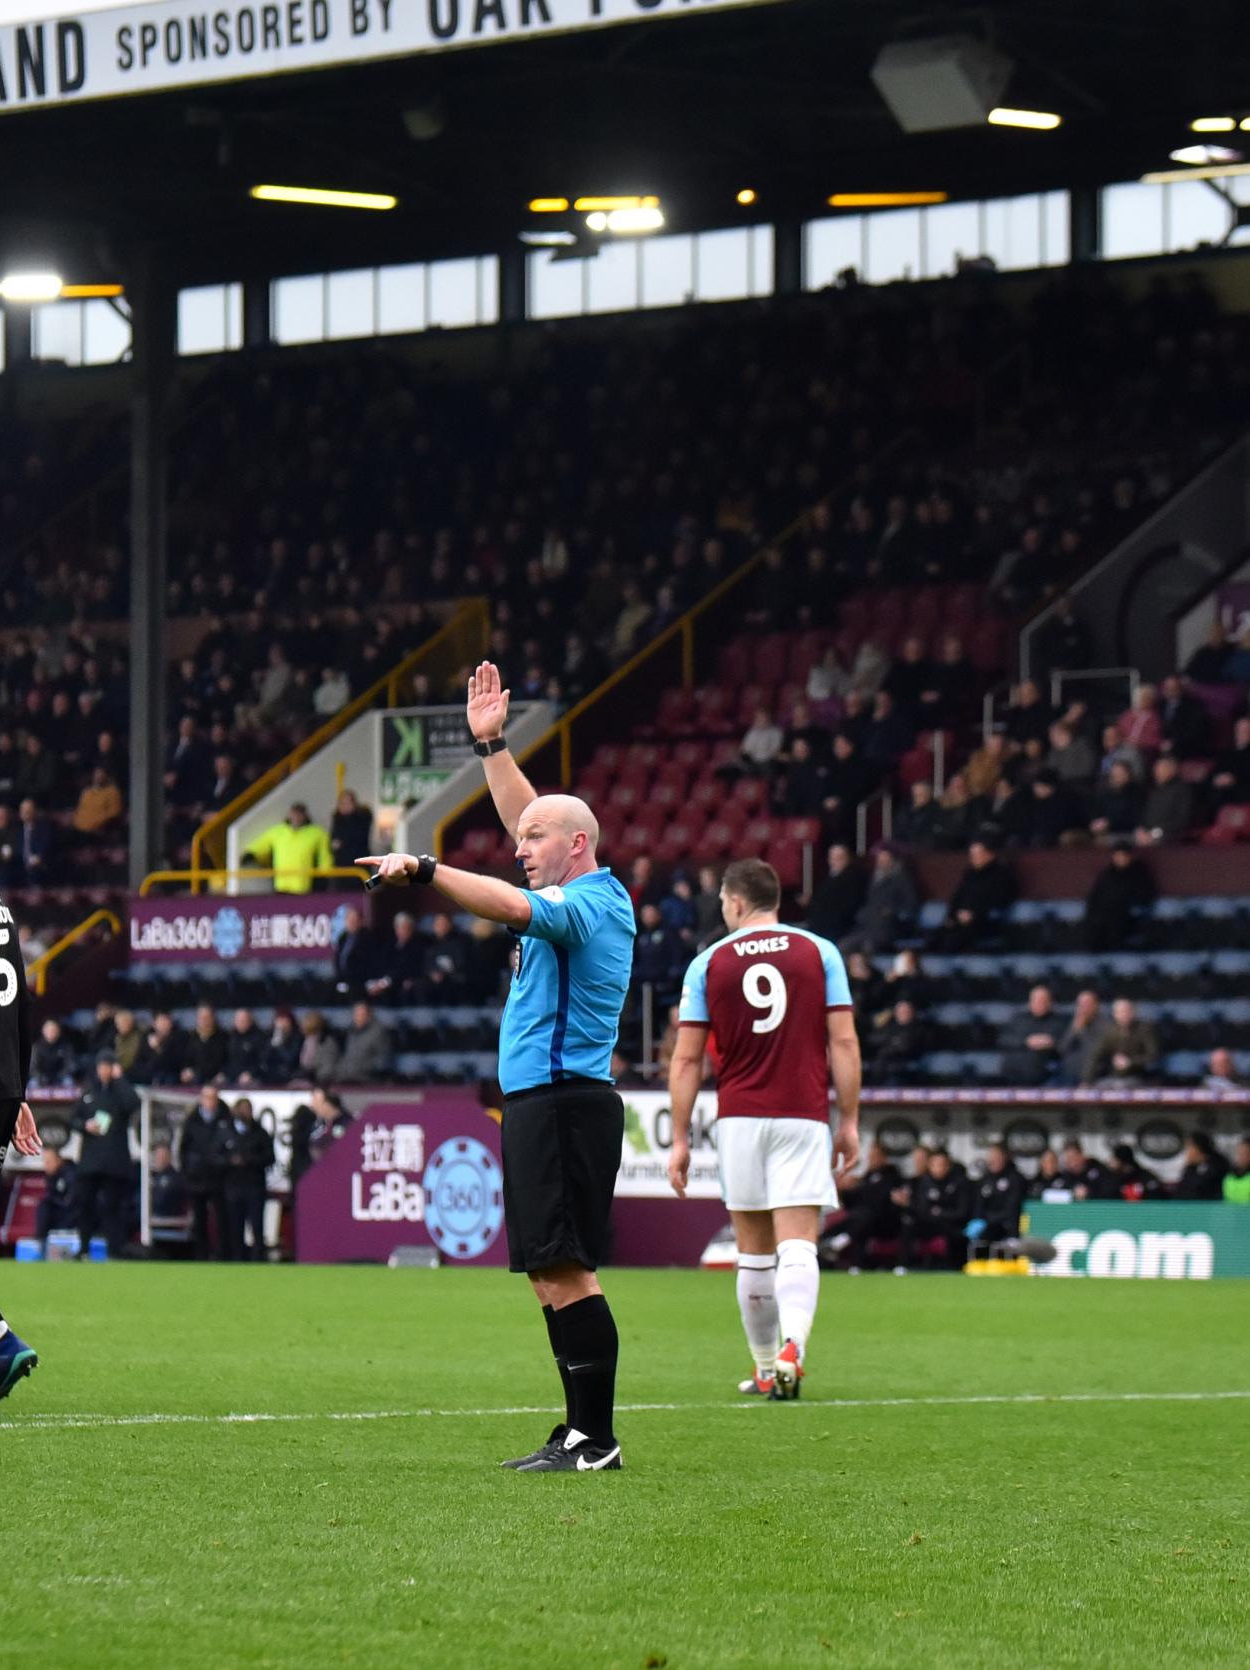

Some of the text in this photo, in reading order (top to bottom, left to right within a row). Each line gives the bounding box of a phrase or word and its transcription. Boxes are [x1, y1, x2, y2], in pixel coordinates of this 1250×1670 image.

[116, 0, 331, 71] SPONSORED
[350, 0, 395, 36] BY
[130, 915, 212, 950] LaBa360
[733, 936, 790, 957] VOKES
[742, 963, 787, 1034] 9
[351, 1171, 425, 1222] LaBa
